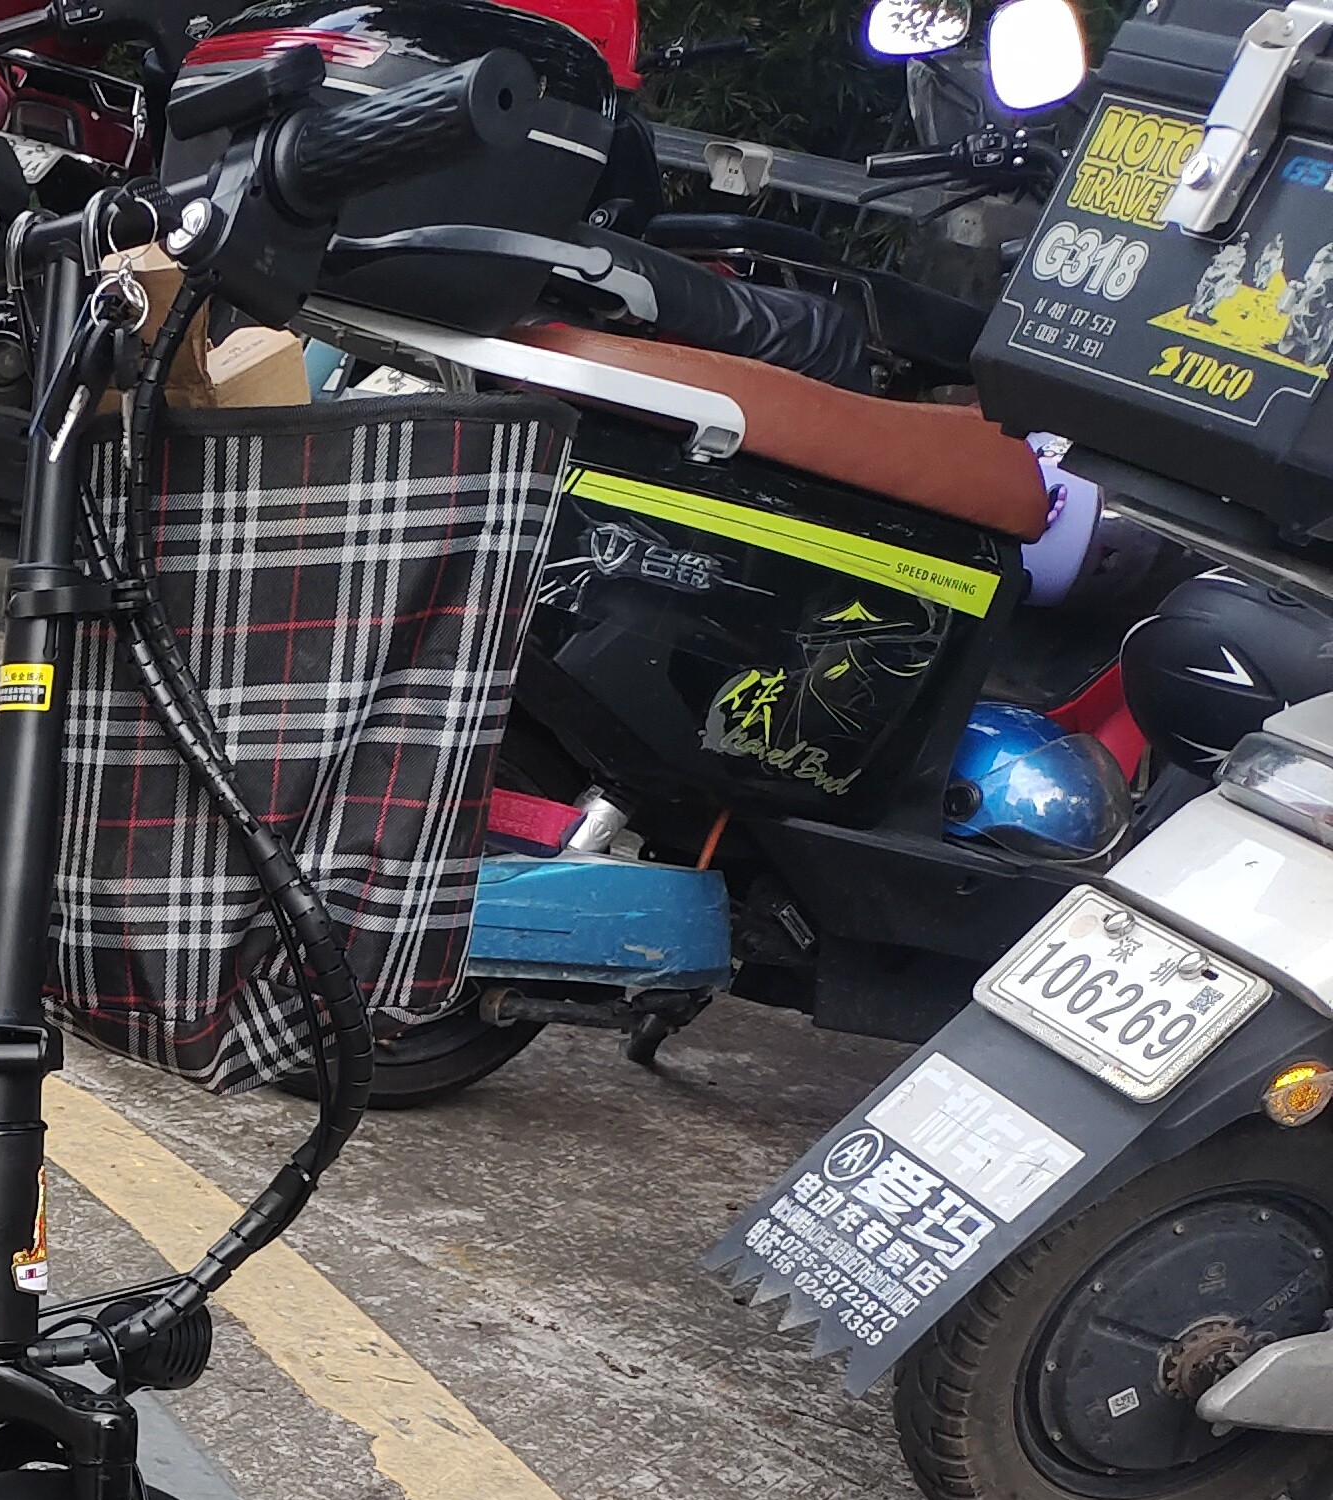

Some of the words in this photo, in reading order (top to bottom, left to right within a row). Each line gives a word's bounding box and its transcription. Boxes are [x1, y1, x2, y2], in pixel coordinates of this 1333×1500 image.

[1084, 105, 1206, 183] MOTO
[1033, 221, 1150, 301] G318
[896, 562, 930, 581] SPEED
[930, 572, 977, 596] RUNNING
[1018, 940, 1197, 1060] 106269
[791, 1171, 949, 1297] 电动车专卖店
[851, 1150, 997, 1271] 爱玛
[794, 1270, 839, 1310] 0246
[838, 1307, 884, 1347] 4359
